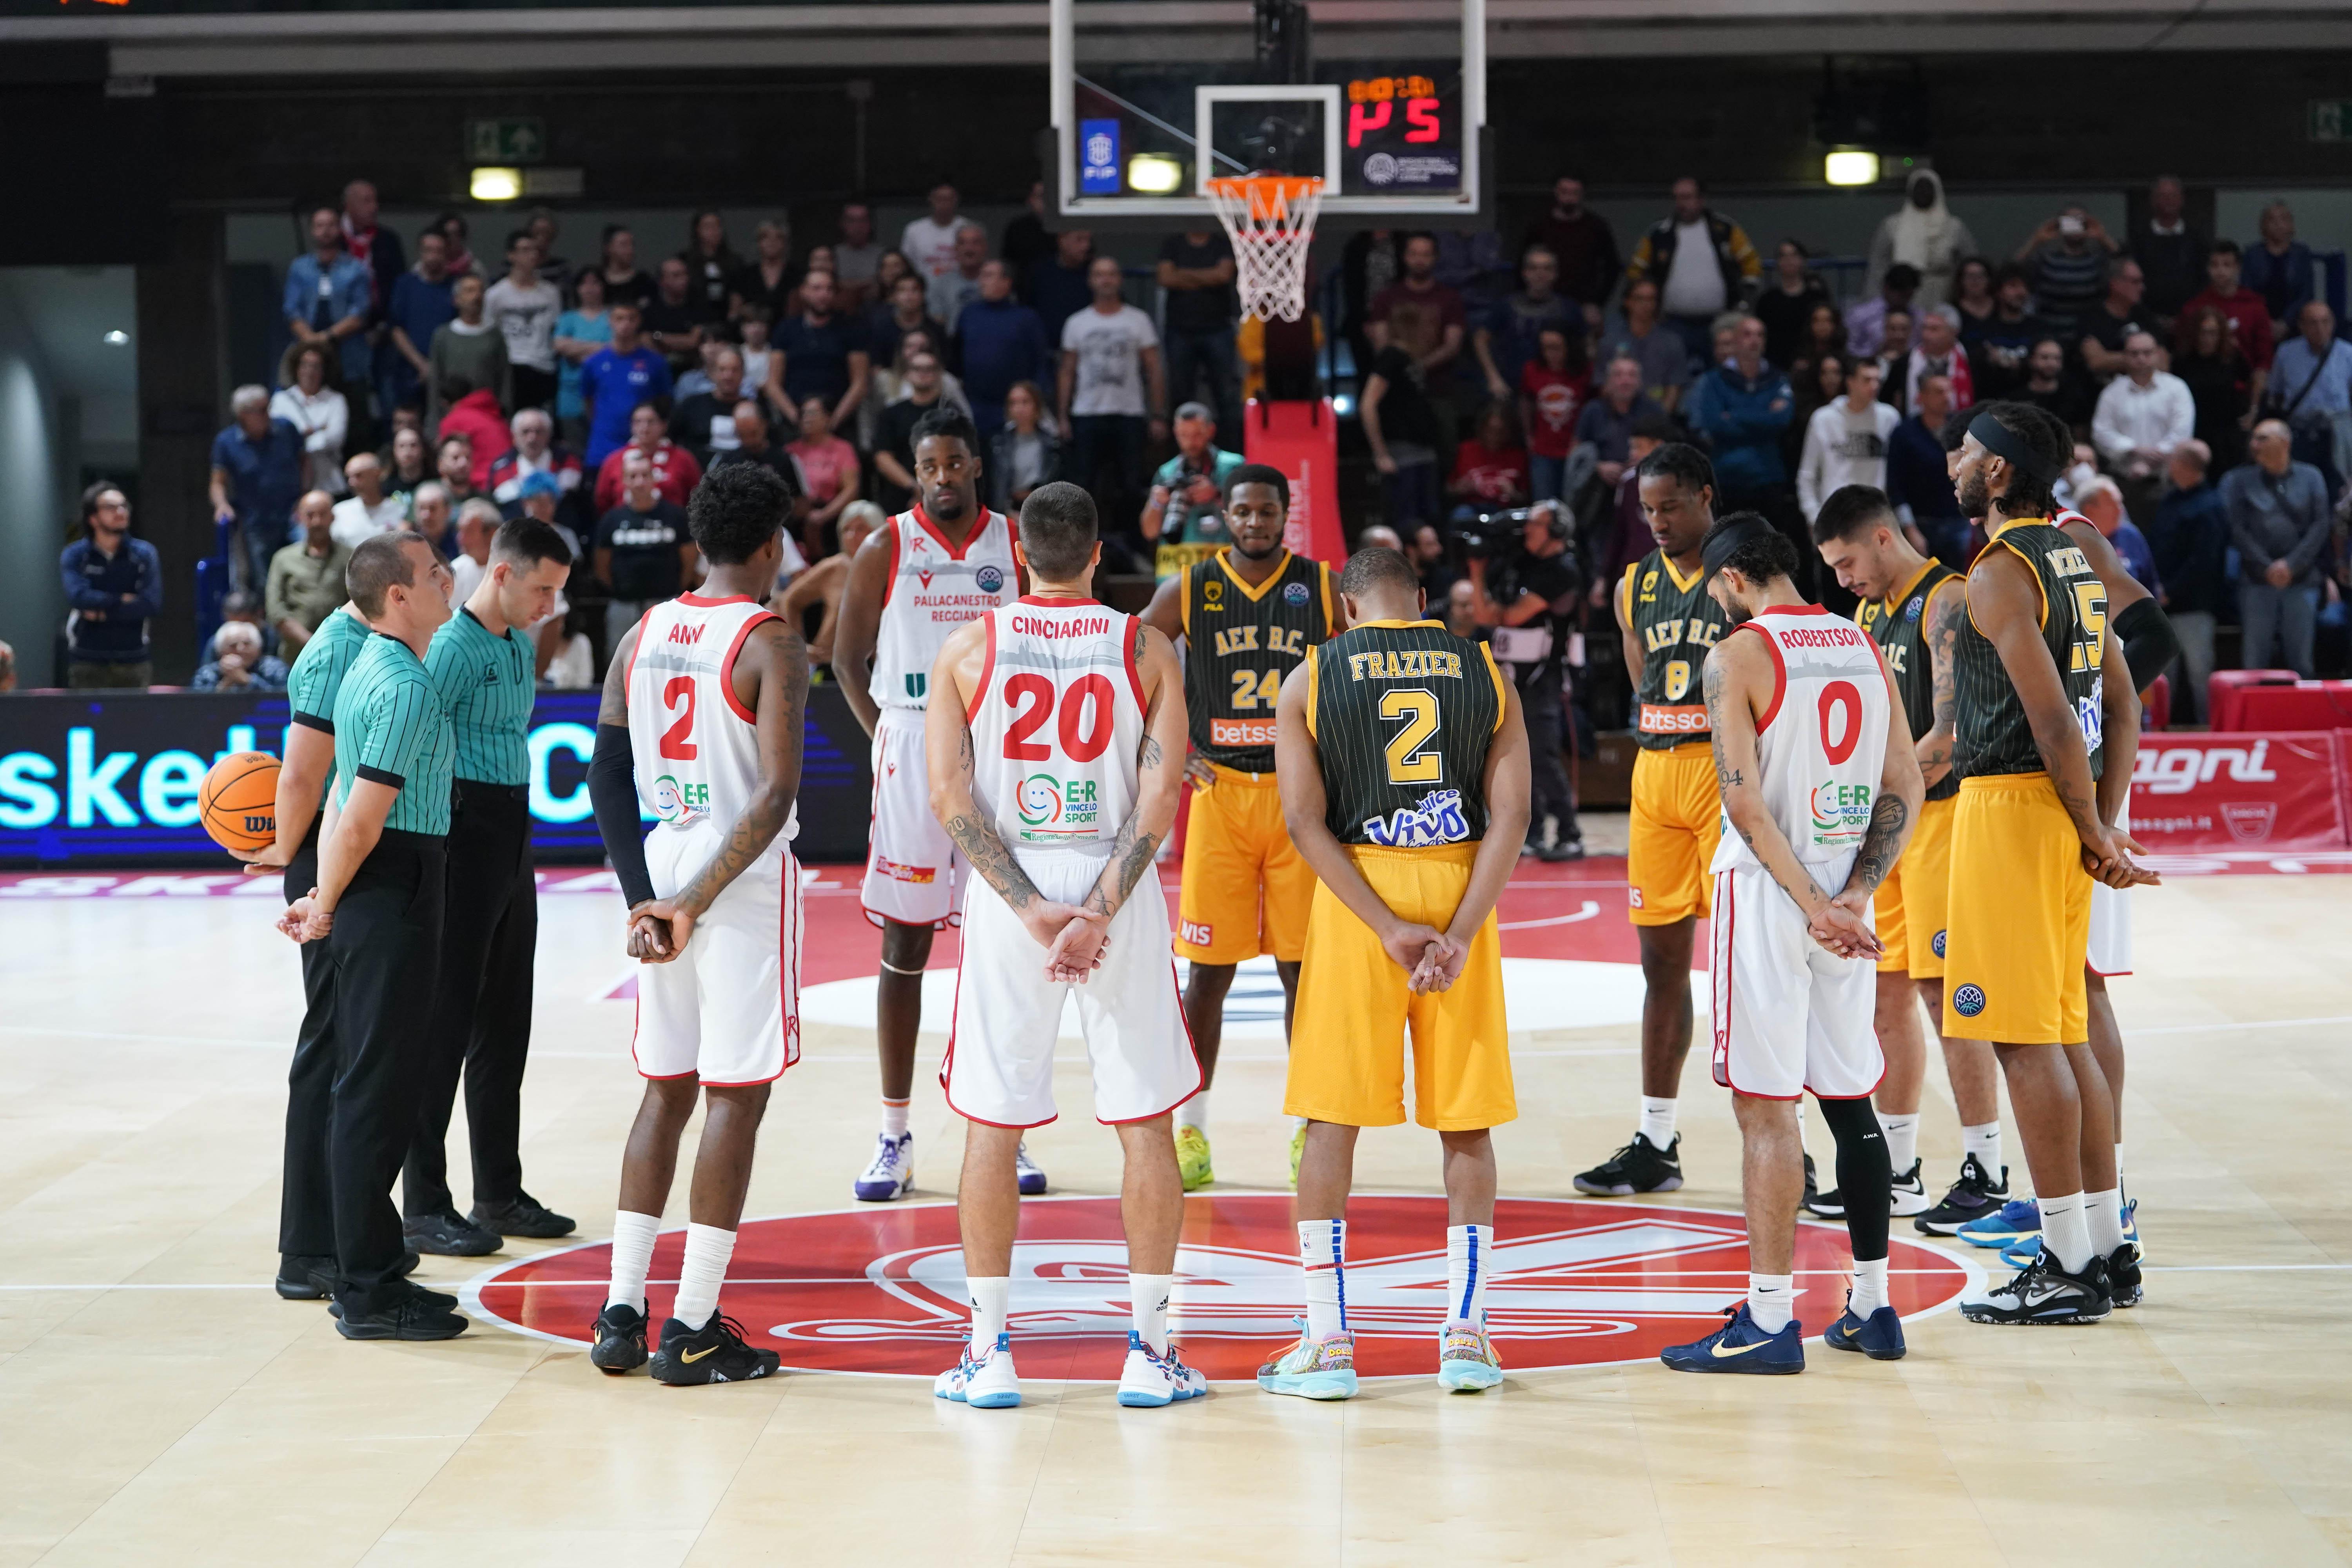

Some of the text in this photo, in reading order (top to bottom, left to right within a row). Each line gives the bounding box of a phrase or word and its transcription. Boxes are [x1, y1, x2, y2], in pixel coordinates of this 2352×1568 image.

[914, 595, 1001, 607] PALLACANESTRO
[1011, 616, 1109, 639] CINCIARINI
[1215, 625, 1304, 657] AEK B.C.
[1779, 628, 1865, 650] ROBERTSON
[1348, 651, 1462, 682] FRAZIER
[1232, 669, 1281, 710] 24
[1664, 660, 1691, 701] 8
[660, 675, 697, 760] 2
[1003, 673, 1115, 762] 20
[1818, 680, 1862, 766] 0
[1378, 688, 1443, 784] 2
[1066, 780, 1097, 802] E-R
[1838, 785, 1870, 806] E-R
[1065, 812, 1097, 823] SPORT
[1841, 816, 1869, 825] PORT
[1448, 1337, 1478, 1351] DOLLA
